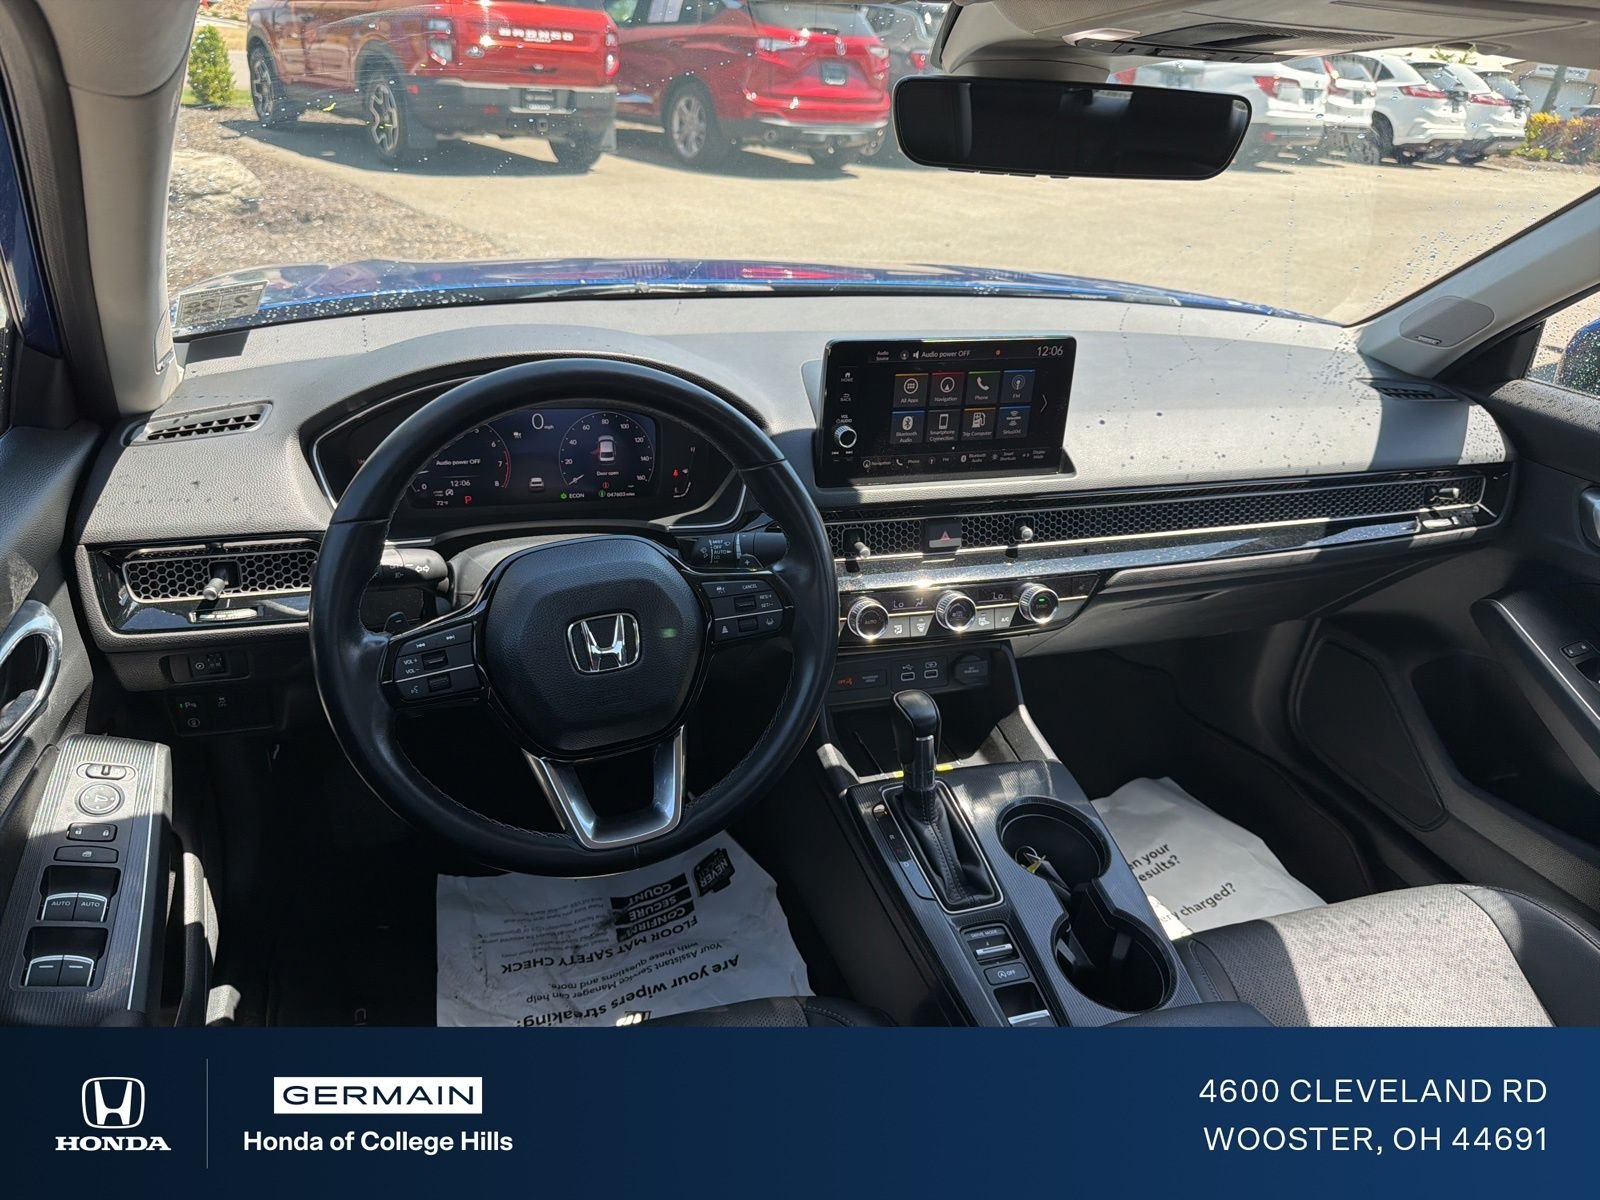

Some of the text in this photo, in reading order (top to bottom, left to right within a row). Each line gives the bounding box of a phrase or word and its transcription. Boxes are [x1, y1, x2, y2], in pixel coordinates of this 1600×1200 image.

[939, 351, 957, 359] power
[1037, 345, 1063, 357] 12:06
[532, 413, 544, 430] 0
[464, 495, 472, 504] P
[893, 600, 904, 608] Lo
[1142, 843, 1171, 865] your
[700, 858, 728, 888] NEVER
[1138, 854, 1181, 882] esults?
[628, 883, 671, 906] COUNT
[1180, 882, 1237, 916] charged?
[629, 895, 677, 921] SECURE
[626, 906, 686, 937] CONFIRM
[651, 915, 698, 941] FLOOR
[617, 937, 647, 954] MAT
[677, 942, 699, 952] with
[700, 942, 722, 954] Your
[559, 948, 613, 966] SAFETY
[649, 949, 676, 961] these
[655, 950, 698, 970] Assistant
[712, 954, 740, 972] Are
[502, 957, 555, 974] CHECK
[602, 959, 647, 980] questions
[580, 979, 599, 989] and
[619, 966, 653, 984] Service
[671, 965, 709, 988] your
[572, 981, 617, 998] Manager
[611, 983, 668, 1009] wipers
[526, 994, 550, 1004] help
